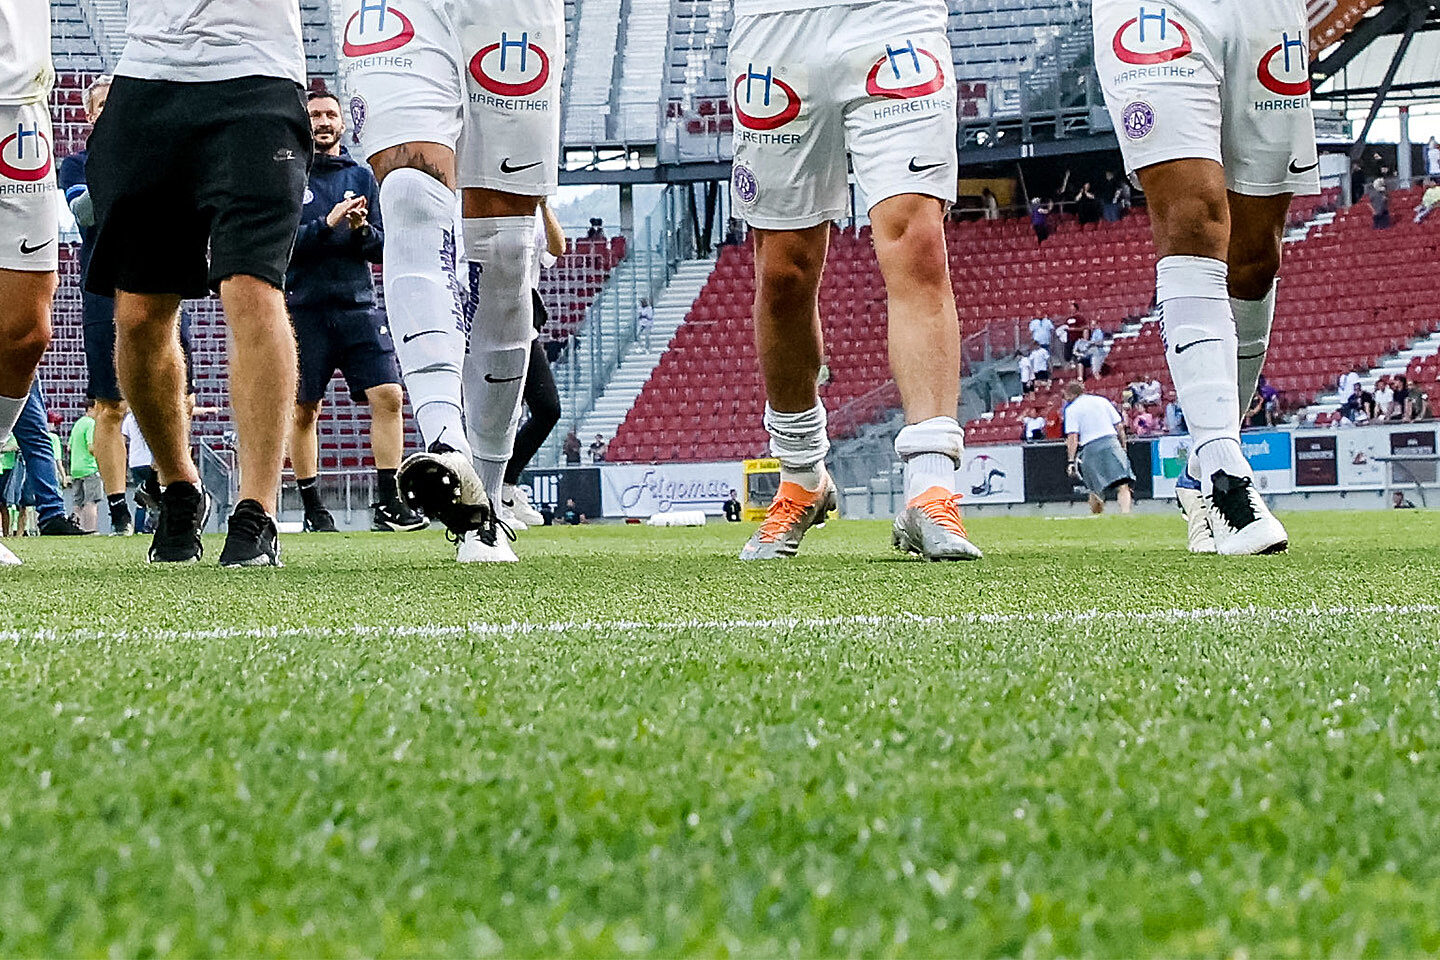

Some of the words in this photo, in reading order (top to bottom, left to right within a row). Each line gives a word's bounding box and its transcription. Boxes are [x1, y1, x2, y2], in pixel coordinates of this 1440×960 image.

[1114, 65, 1195, 86] HARREITHER
[469, 93, 549, 111] HARREITHER
[1255, 97, 1309, 111] HARREIT
